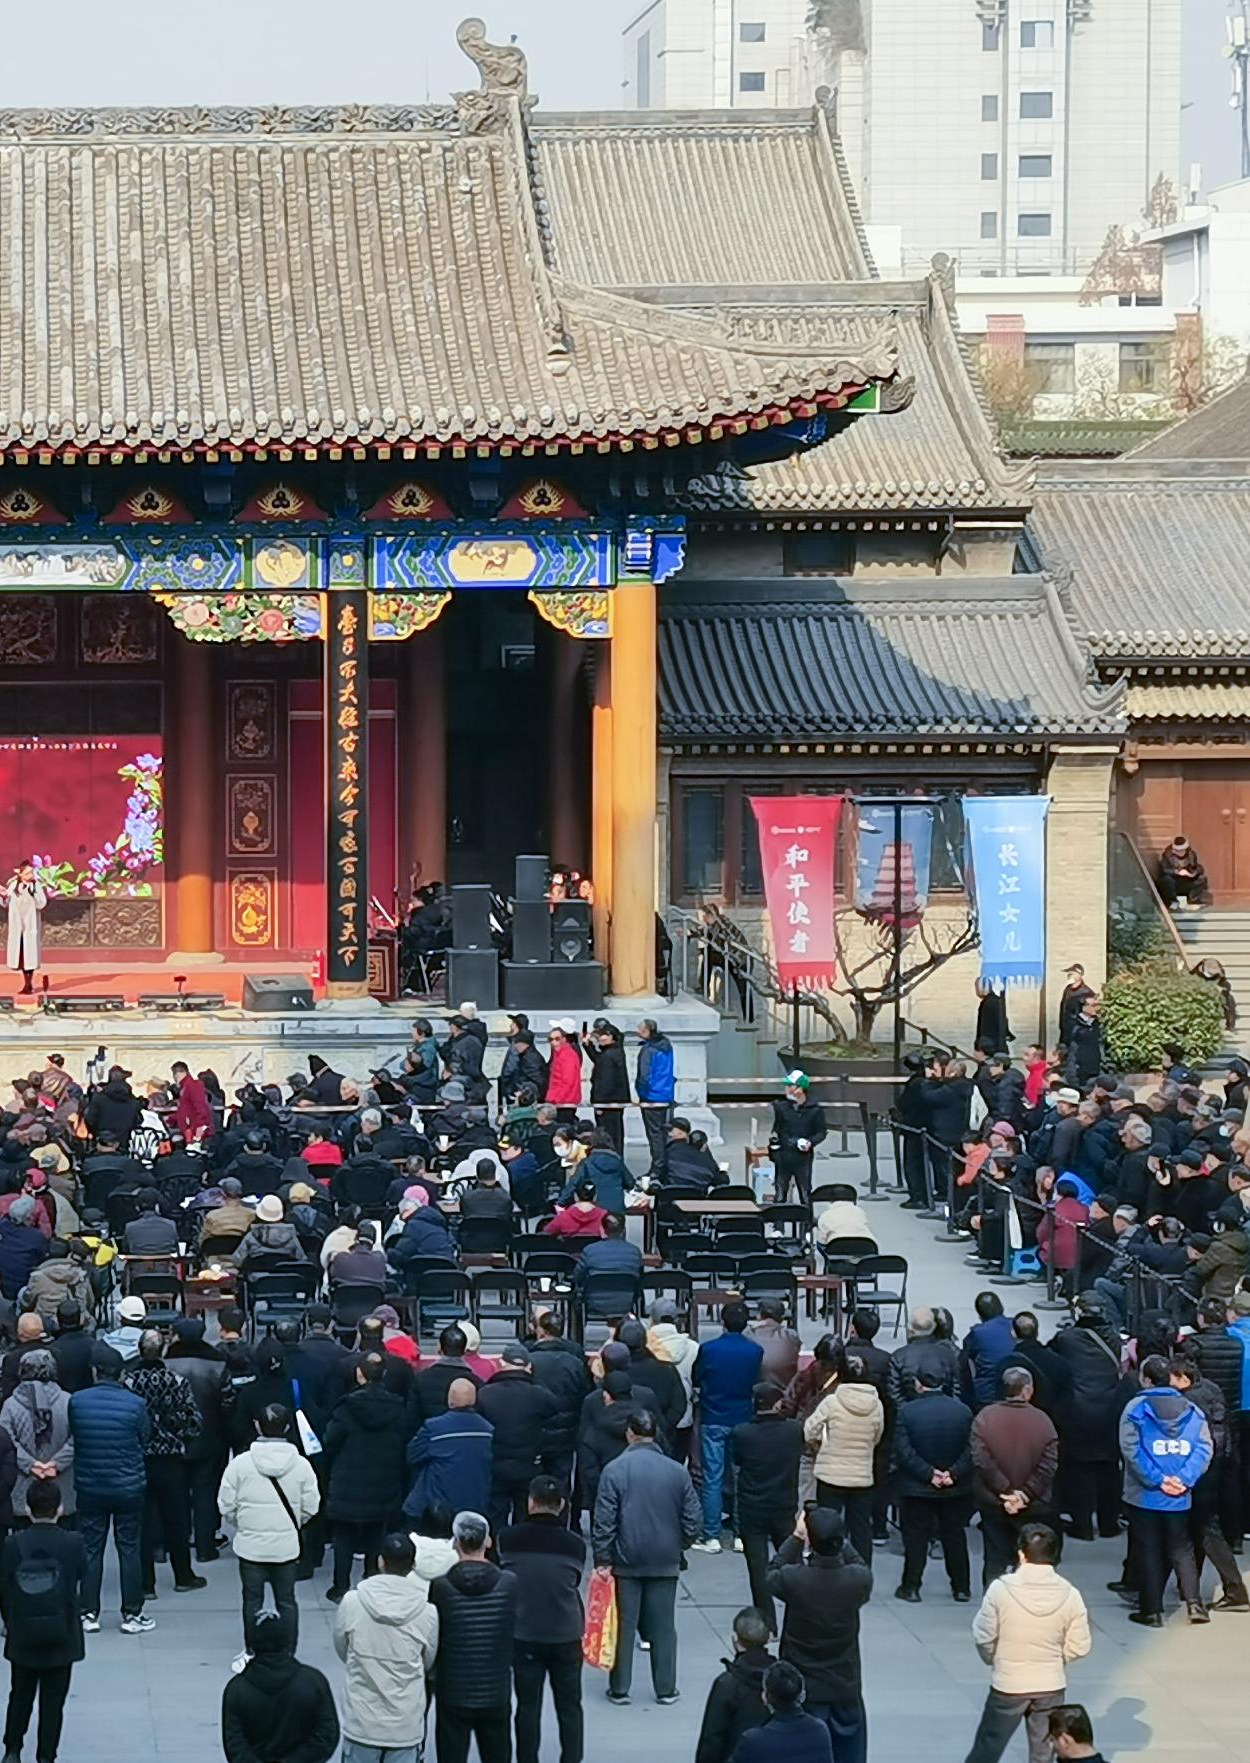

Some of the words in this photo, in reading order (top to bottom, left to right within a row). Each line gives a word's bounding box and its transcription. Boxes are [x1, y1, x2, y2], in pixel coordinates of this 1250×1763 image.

[782, 843, 812, 954] 和平使者
[998, 843, 1022, 952] 长江女儿
